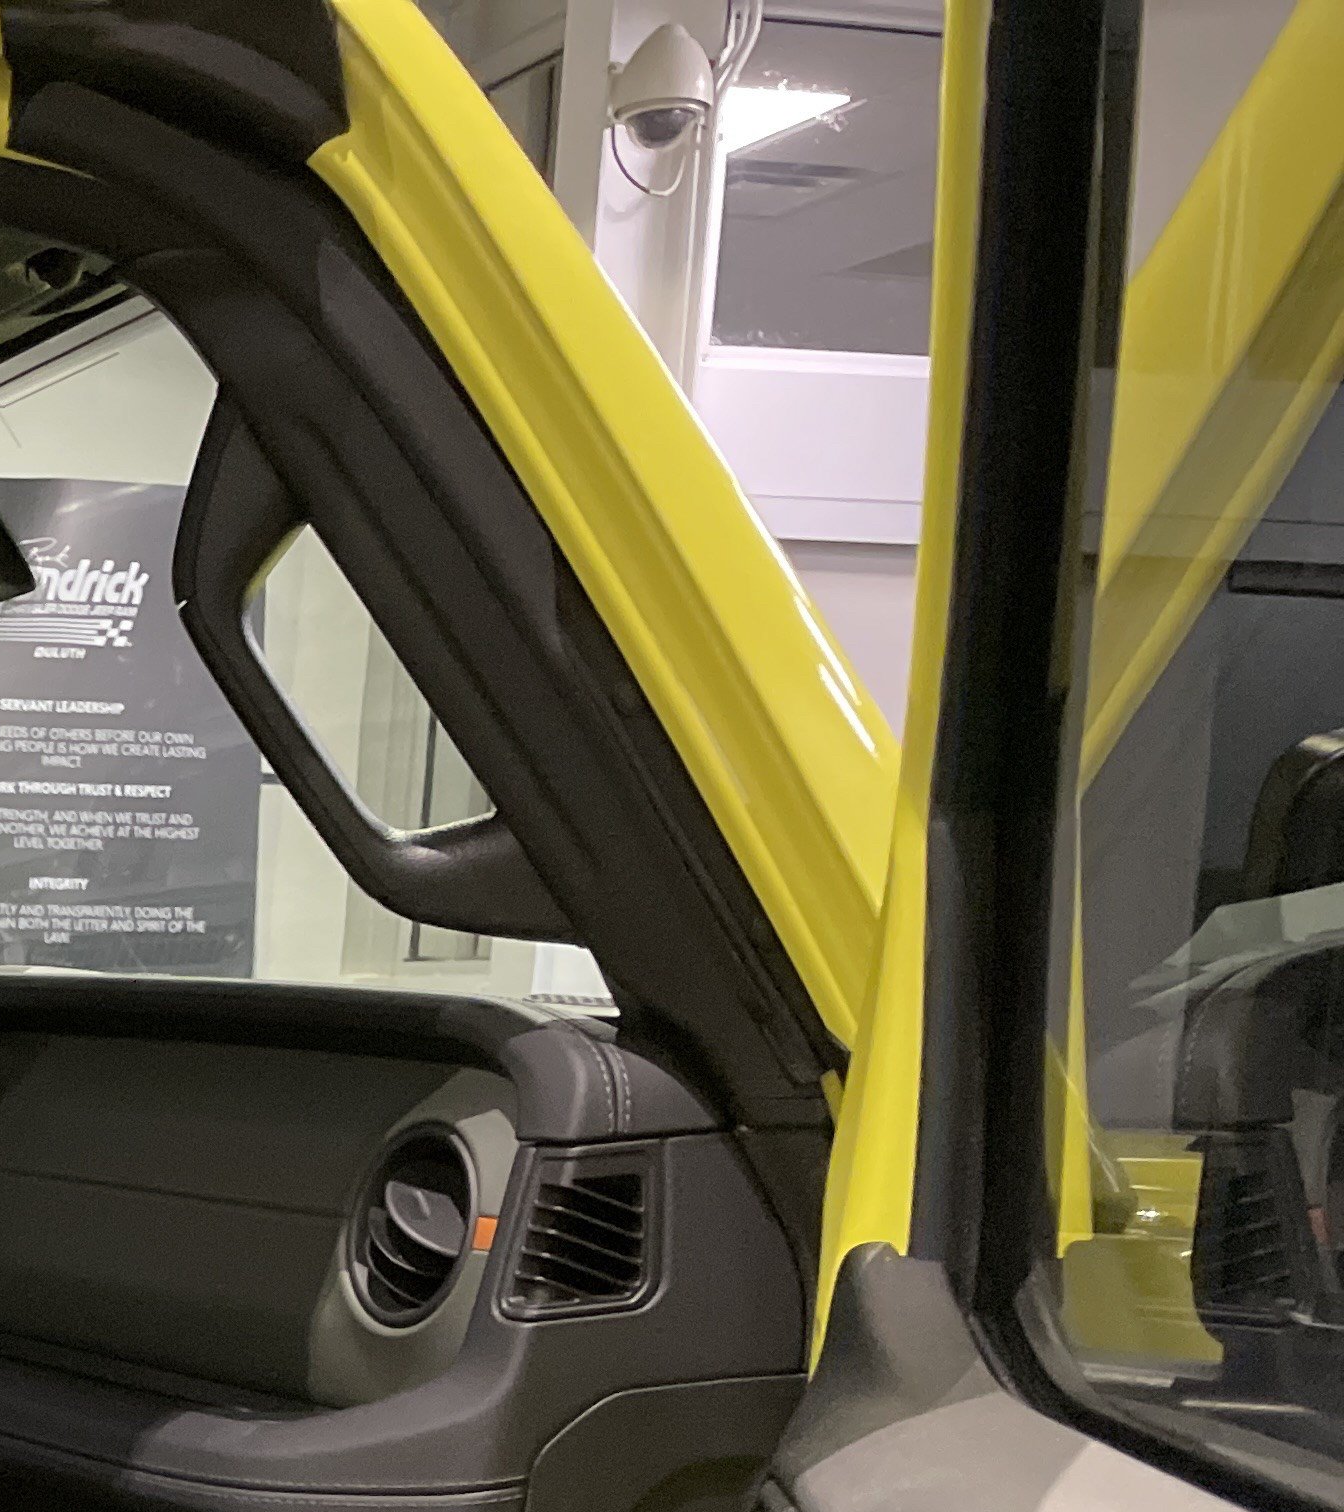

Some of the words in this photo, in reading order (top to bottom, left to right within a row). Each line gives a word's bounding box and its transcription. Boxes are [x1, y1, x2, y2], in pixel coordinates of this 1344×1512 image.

[6, 559, 150, 608] ndrick
[33, 646, 86, 659] DULUTH
[0, 698, 54, 712] SERVANT
[55, 700, 125, 715] LEADERSHIP
[30, 727, 47, 739] OF
[137, 730, 162, 743] OUR
[163, 731, 195, 745] OWN
[14, 740, 55, 754] PEOPLE
[56, 741, 67, 754] IS
[68, 742, 99, 755] HOW
[101, 743, 119, 756] WE
[120, 743, 160, 757] CREATE
[162, 746, 207, 759] LASTING
[17, 781, 77, 795] THROUGH
[78, 783, 113, 797] TRUST
[113, 784, 123, 797] &
[123, 784, 172, 798] RESPECT
[53, 810, 78, 823] AND
[78, 810, 113, 824] WHEN
[114, 811, 133, 824] WE
[135, 812, 167, 825] TRUST
[168, 813, 194, 826] AND
[48, 824, 67, 836] WE
[116, 825, 131, 838] AT
[133, 826, 153, 839] THE
[154, 826, 200, 840] HIGHEST
[13, 836, 45, 850] LEVEL
[28, 877, 89, 891] INTEGRITY
[18, 904, 45, 916] AND
[134, 906, 172, 920] DOING
[174, 906, 195, 920] THE
[18, 917, 50, 930] BOTH
[51, 918, 72, 931] THE
[109, 919, 134, 932] AND
[167, 920, 185, 934] OF
[186, 920, 206, 934] THE
